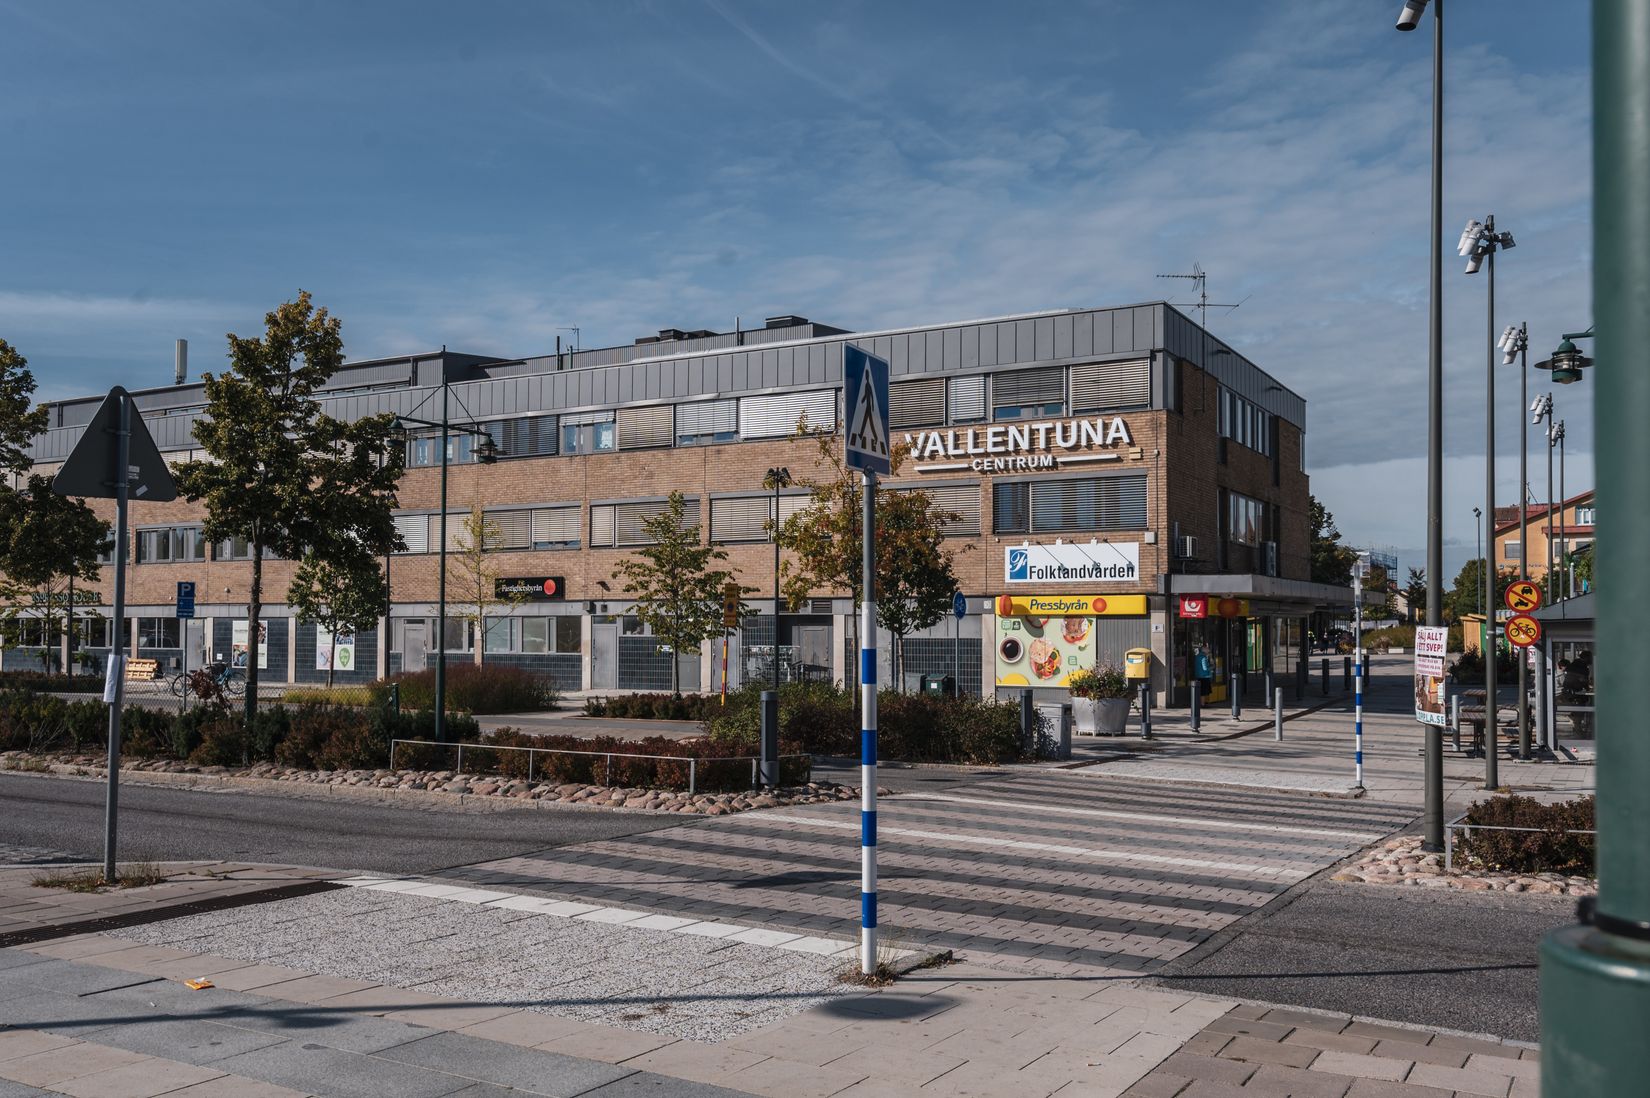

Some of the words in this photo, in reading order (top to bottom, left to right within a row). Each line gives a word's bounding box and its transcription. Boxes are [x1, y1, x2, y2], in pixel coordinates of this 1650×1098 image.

[904, 417, 1131, 458] VALLENTUNA
[972, 454, 1053, 471] CENTRUM
[1029, 562, 1135, 580] Folktandvården
[181, 583, 191, 596] P
[1030, 599, 1089, 613] Pressbyrån
[1427, 632, 1443, 641] ALLT
[1426, 643, 1444, 652] SVEP!
